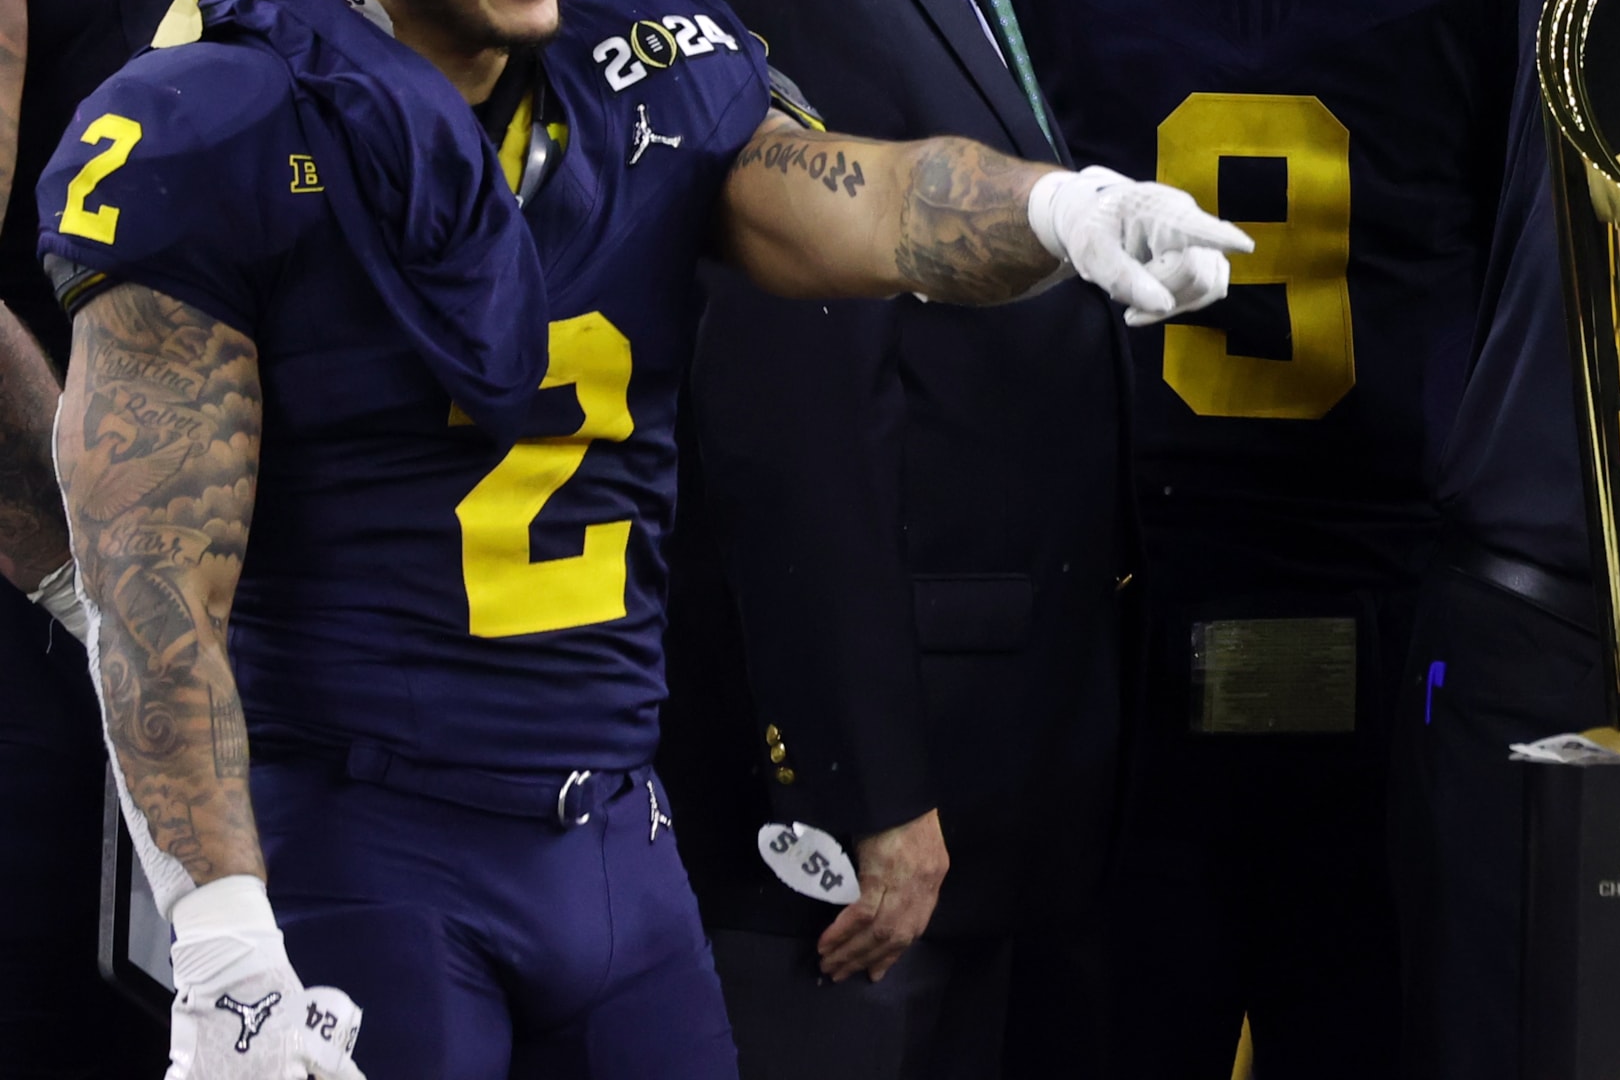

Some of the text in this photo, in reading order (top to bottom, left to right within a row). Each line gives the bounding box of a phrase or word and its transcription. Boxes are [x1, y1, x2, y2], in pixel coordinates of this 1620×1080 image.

[58, 112, 145, 245] 2
[1156, 92, 1356, 419] 9
[449, 310, 634, 638] 2
